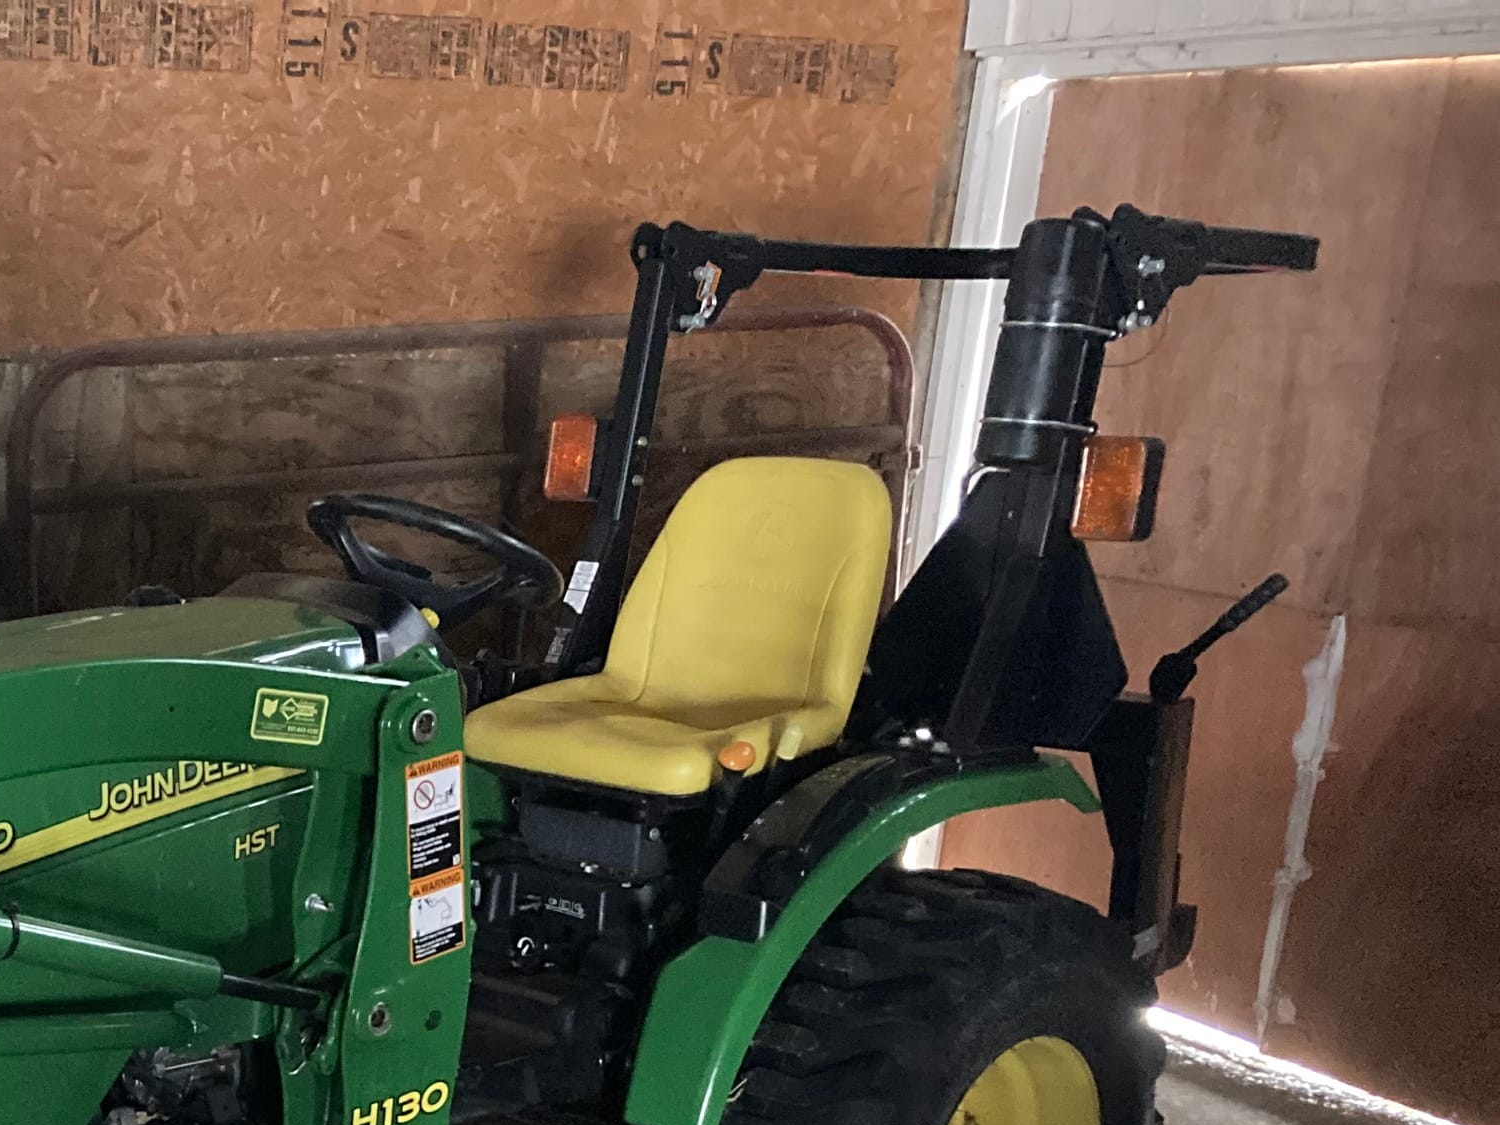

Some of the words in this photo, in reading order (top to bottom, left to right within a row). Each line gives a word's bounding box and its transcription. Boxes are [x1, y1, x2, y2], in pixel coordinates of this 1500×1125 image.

[418, 755, 459, 774] WARNING
[88, 768, 174, 820] JOHN
[178, 760, 258, 792] DEE
[234, 824, 281, 860] HST
[421, 872, 460, 892] WARNING
